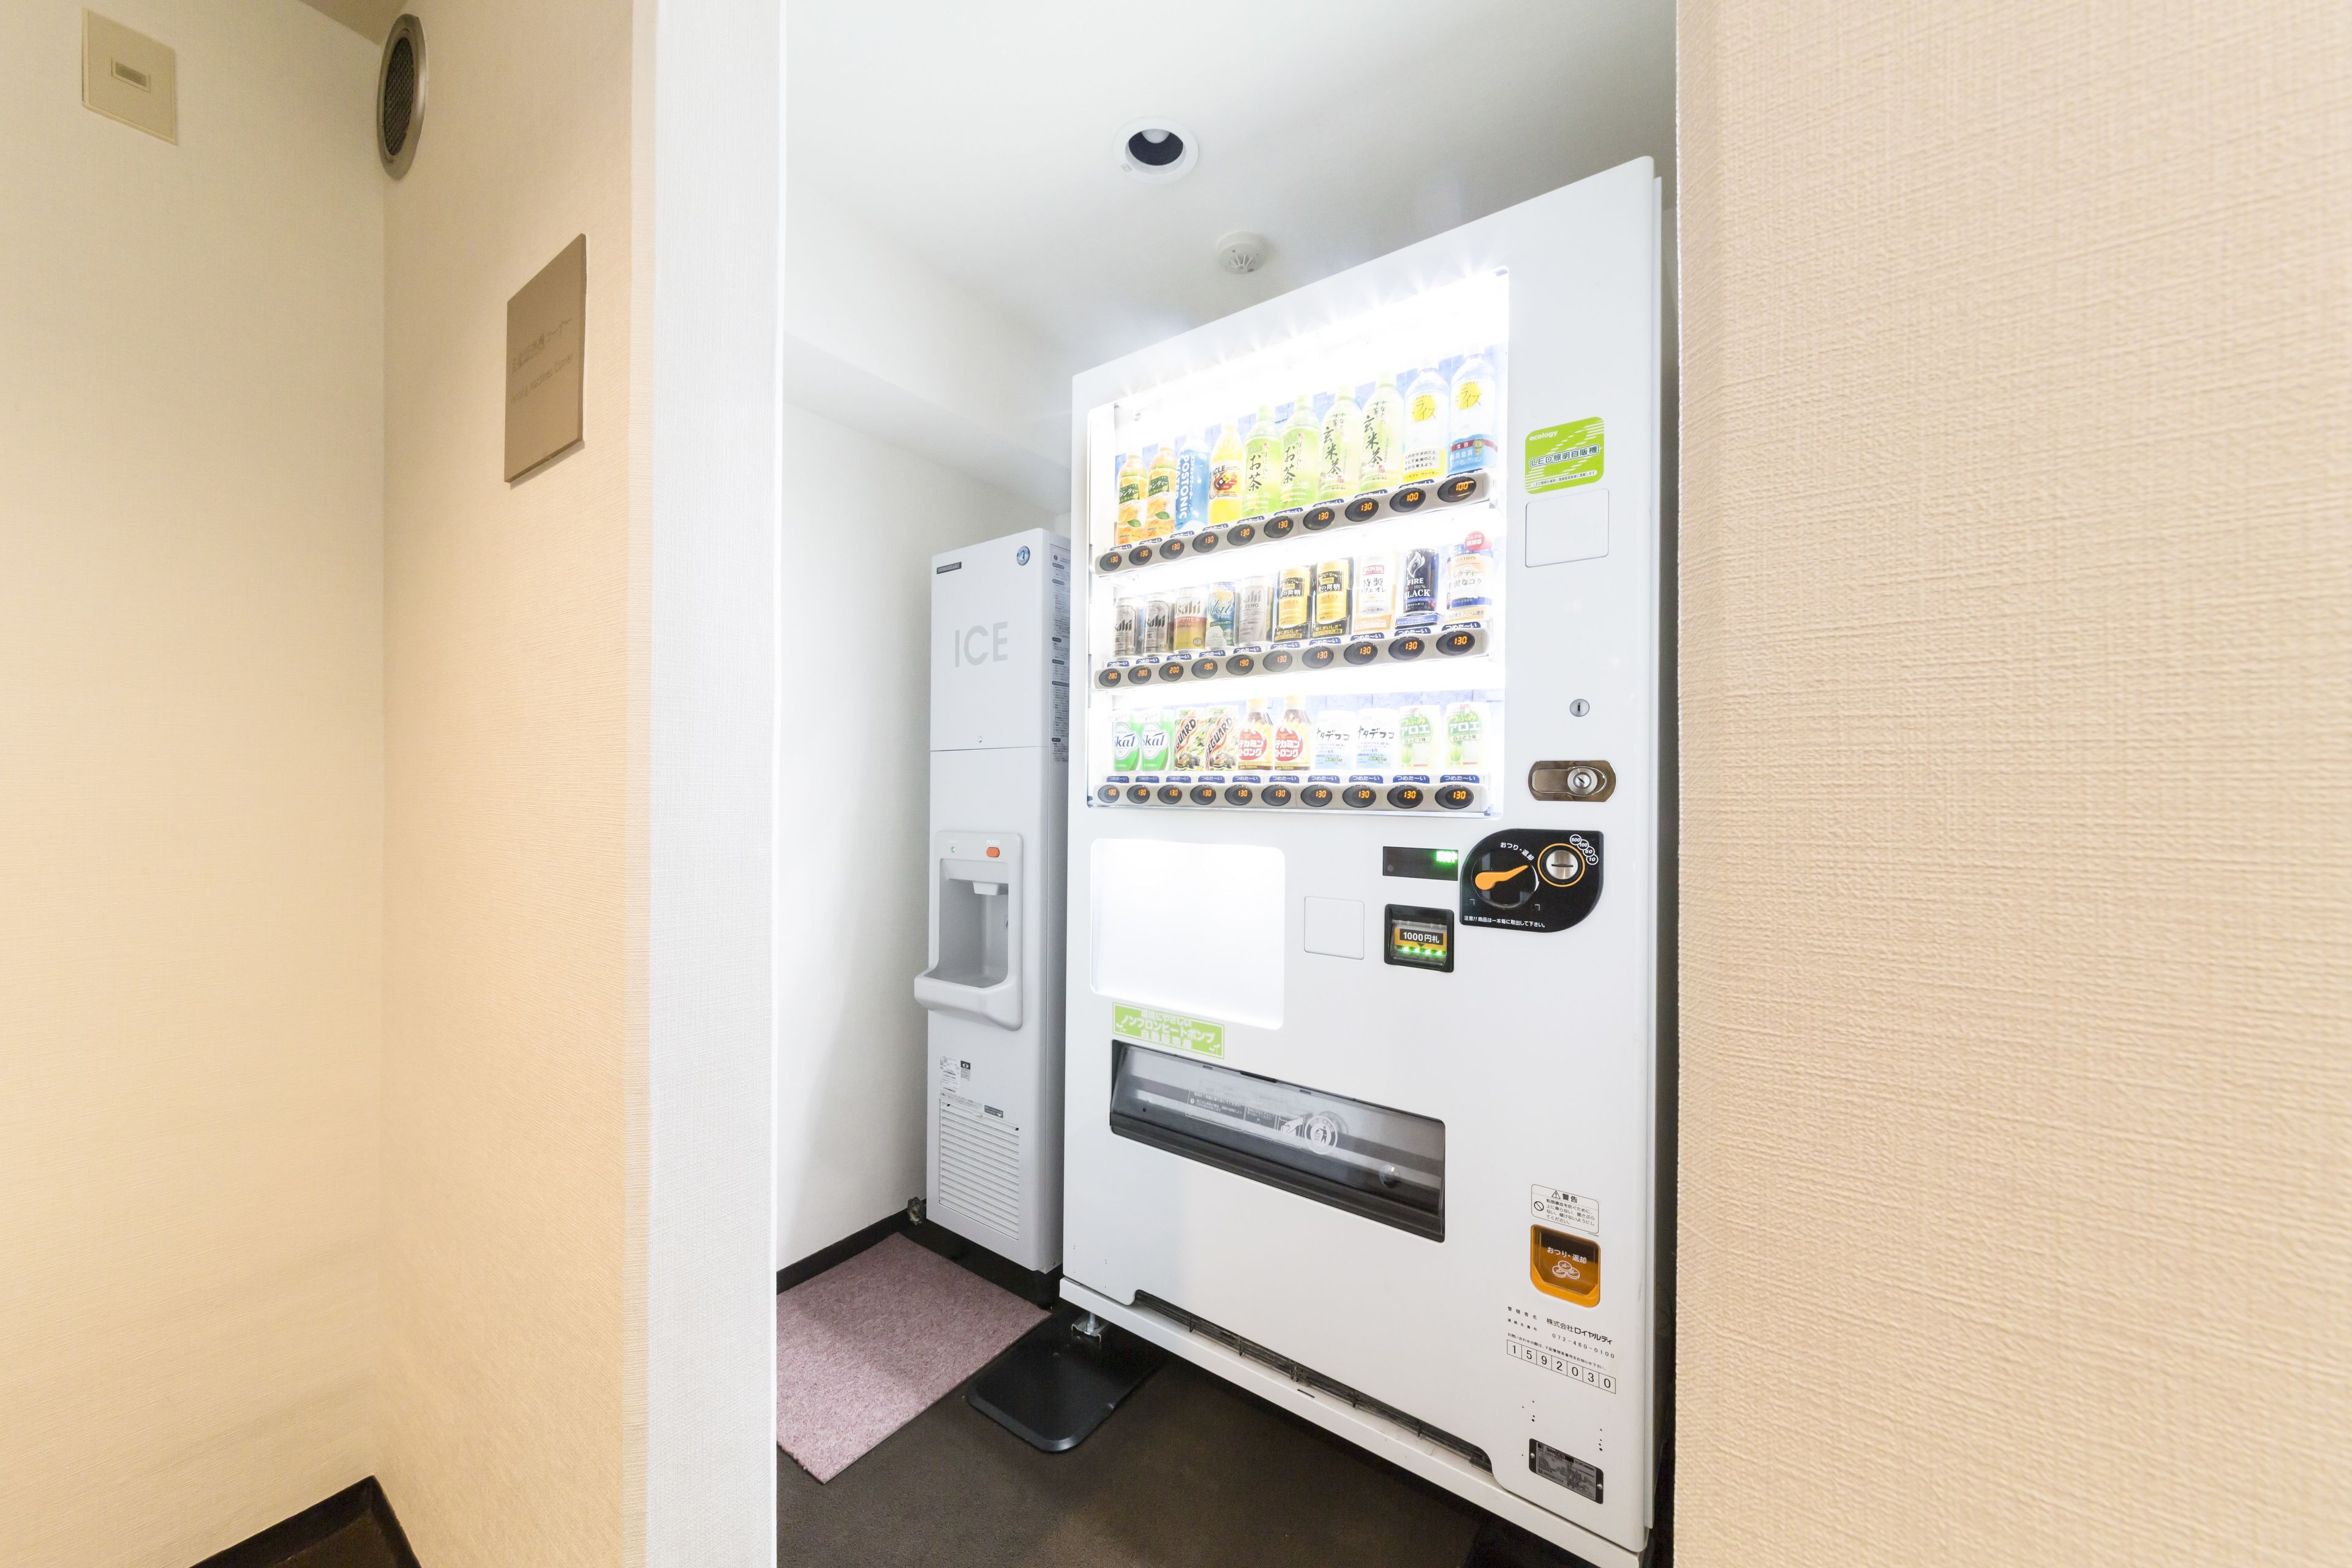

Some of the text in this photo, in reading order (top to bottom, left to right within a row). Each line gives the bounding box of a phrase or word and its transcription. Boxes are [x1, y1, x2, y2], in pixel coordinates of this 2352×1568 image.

[1363, 414, 1383, 467] 玄米茶
[1529, 430, 1558, 442] ecology
[1323, 426, 1342, 475] 玄米茶
[1530, 446, 1599, 467] LED照明自販機
[1283, 445, 1297, 484] お茶
[1248, 454, 1263, 492] お茶
[1178, 454, 1191, 519] POSTONIC
[1406, 492, 1419, 502] 100
[1361, 502, 1373, 511] 130
[1318, 511, 1329, 520] 130
[1278, 520, 1288, 529] 130
[954, 620, 1008, 668] ICE
[1404, 641, 1418, 650] 130
[1453, 636, 1468, 646] 130
[1359, 646, 1371, 655] 130
[1401, 724, 1431, 737] アロエ
[1449, 722, 1481, 733] アロエ
[1358, 790, 1370, 799] 130
[1403, 790, 1417, 799] 130
[1452, 790, 1466, 800] 130
[1500, 842, 1535, 861] おつり・返却
[1403, 930, 1440, 944] 1000円札
[1547, 1246, 1588, 1265] おつり・返却
[1546, 1317, 1613, 1345] 株式会社ロイヤルティ
